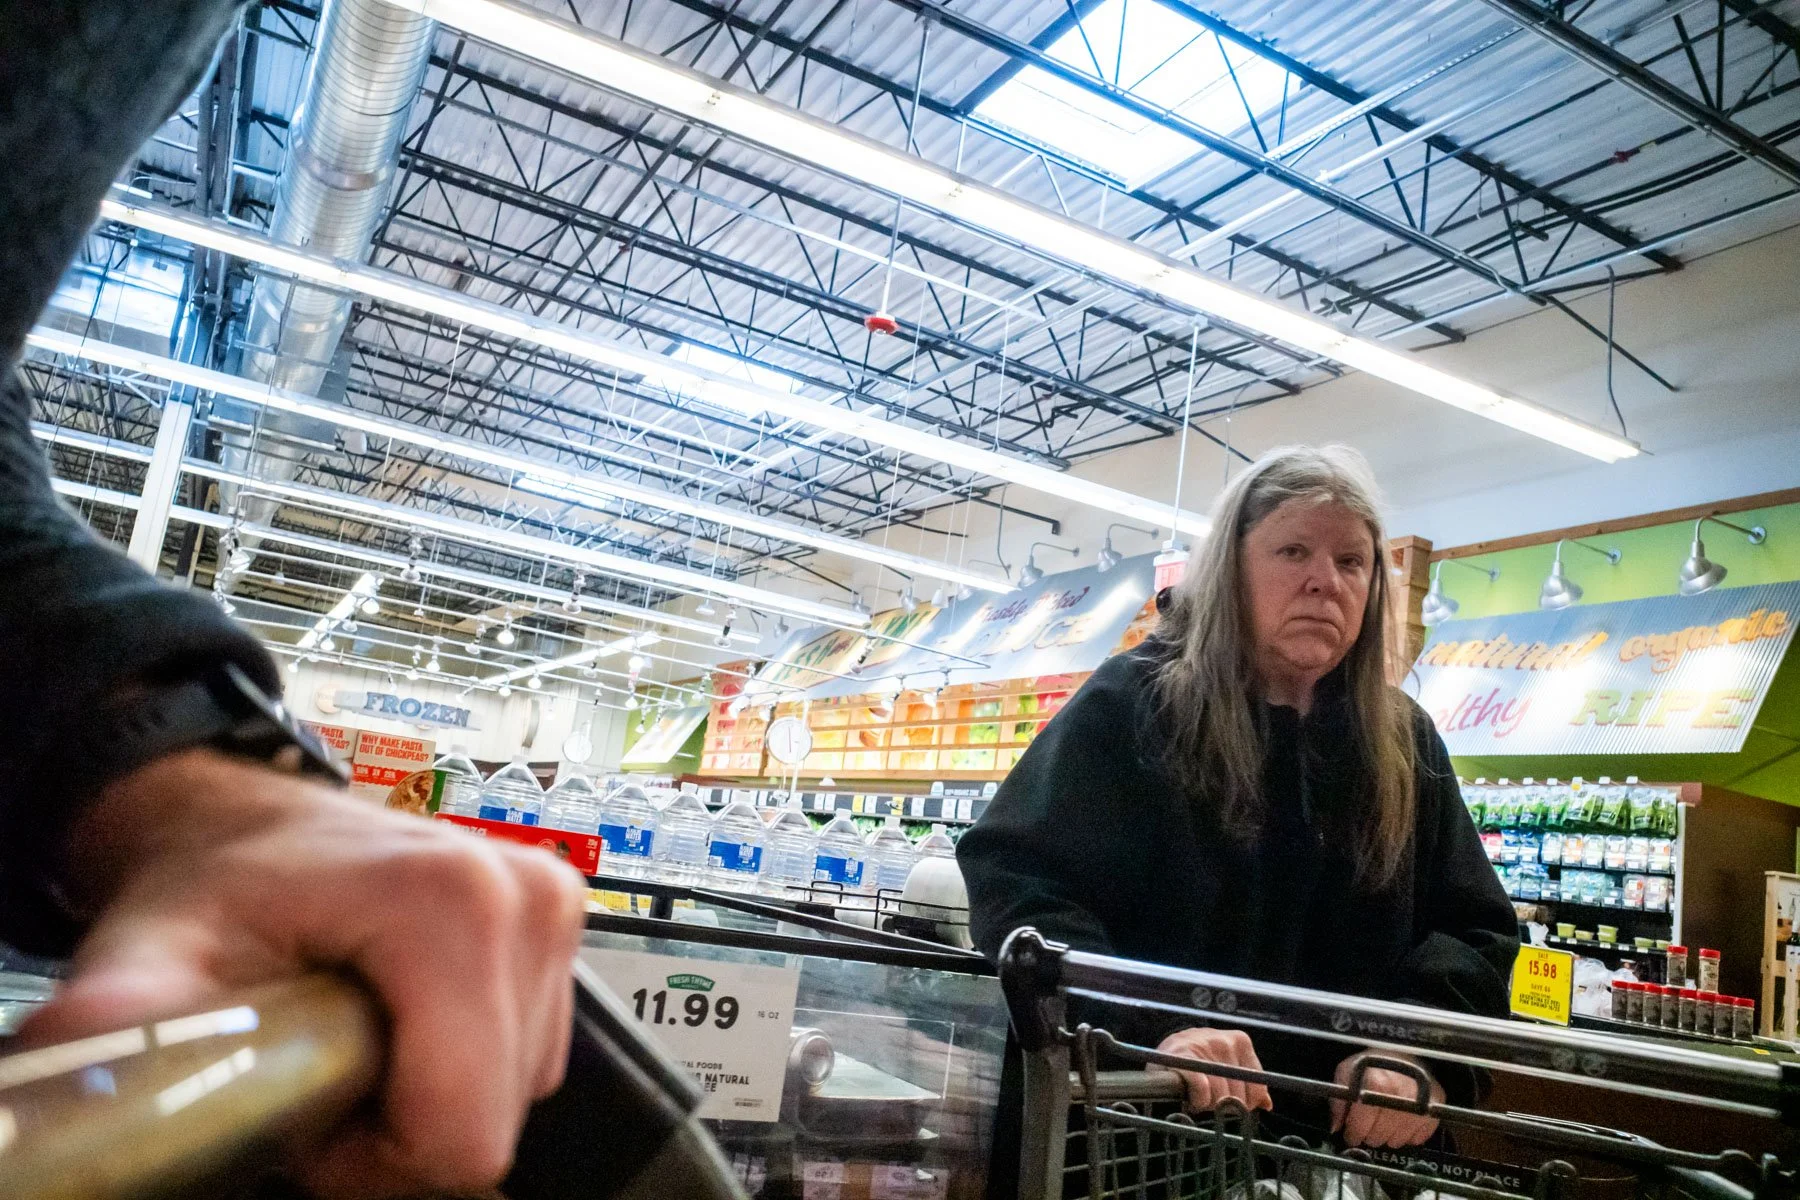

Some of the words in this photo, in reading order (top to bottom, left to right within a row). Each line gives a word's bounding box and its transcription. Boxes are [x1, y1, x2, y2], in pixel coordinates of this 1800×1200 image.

[1418, 631, 1608, 671] natural
[1619, 608, 1790, 673] organic
[364, 691, 471, 727] FROZEN
[1435, 688, 1533, 739] althy
[1568, 689, 1755, 729] RIPE
[321, 726, 344, 739] PASTA
[327, 737, 350, 750] PEAS?
[361, 734, 379, 745] WHY
[379, 736, 400, 748] MAKE
[401, 740, 423, 752] PASTA
[359, 743, 374, 754] OUT
[375, 746, 384, 755] OF
[385, 747, 429, 762] CHICKPEAS?
[1529, 960, 1557, 979] 15.98
[633, 987, 740, 1029] 11.99
[768, 1011, 779, 1019] OZ
[696, 1062, 722, 1070] FOODS
[705, 1073, 750, 1085] NATURAL
[1442, 1163, 1472, 1178] NOT
